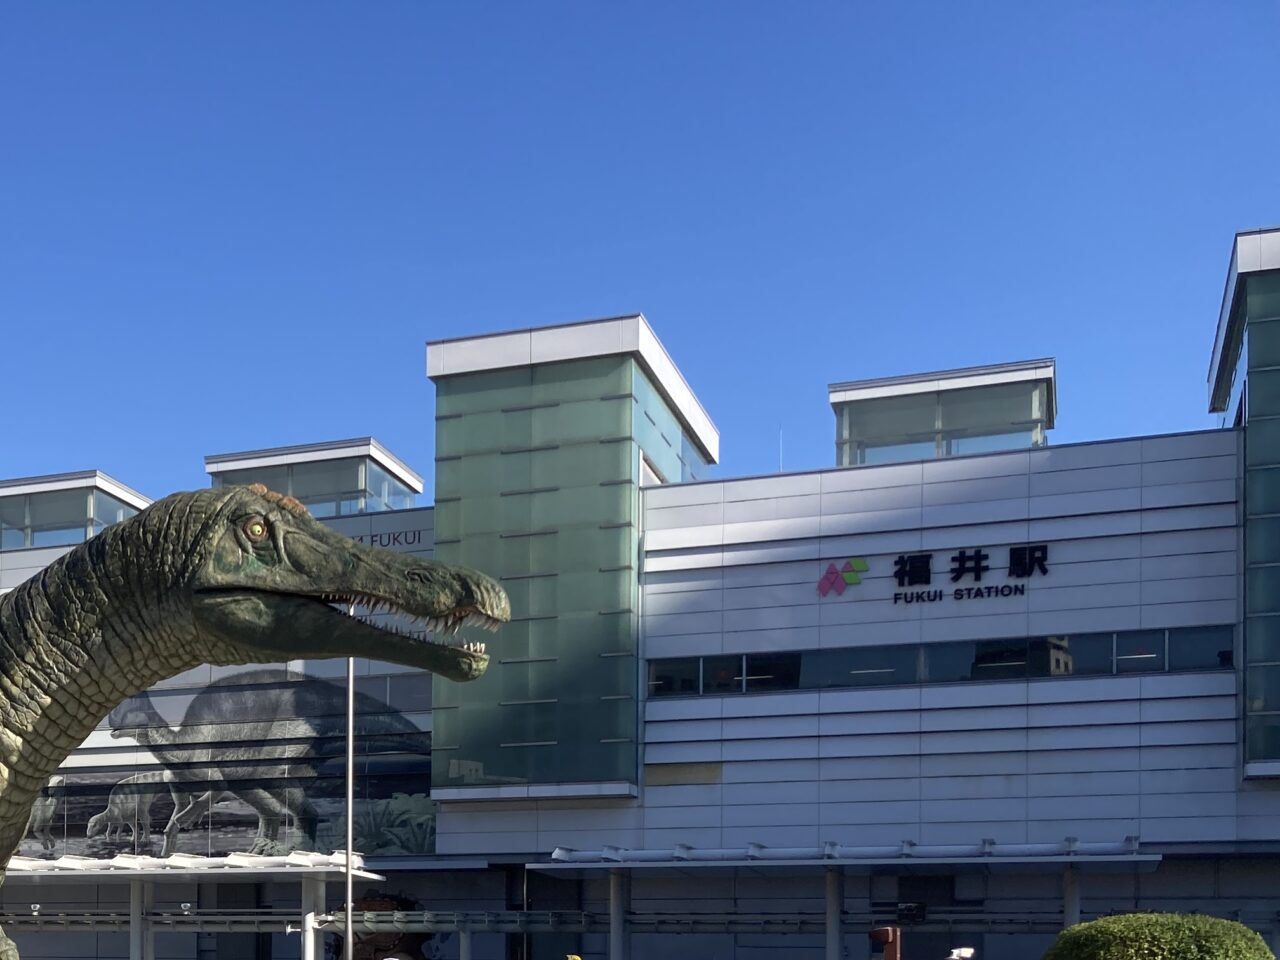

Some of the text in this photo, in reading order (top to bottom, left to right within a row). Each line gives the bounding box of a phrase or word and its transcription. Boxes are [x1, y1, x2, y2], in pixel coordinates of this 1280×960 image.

[371, 531, 421, 547] FUKUI
[893, 544, 1049, 587] 福井駅
[893, 584, 1025, 605] FUKUI STATION
